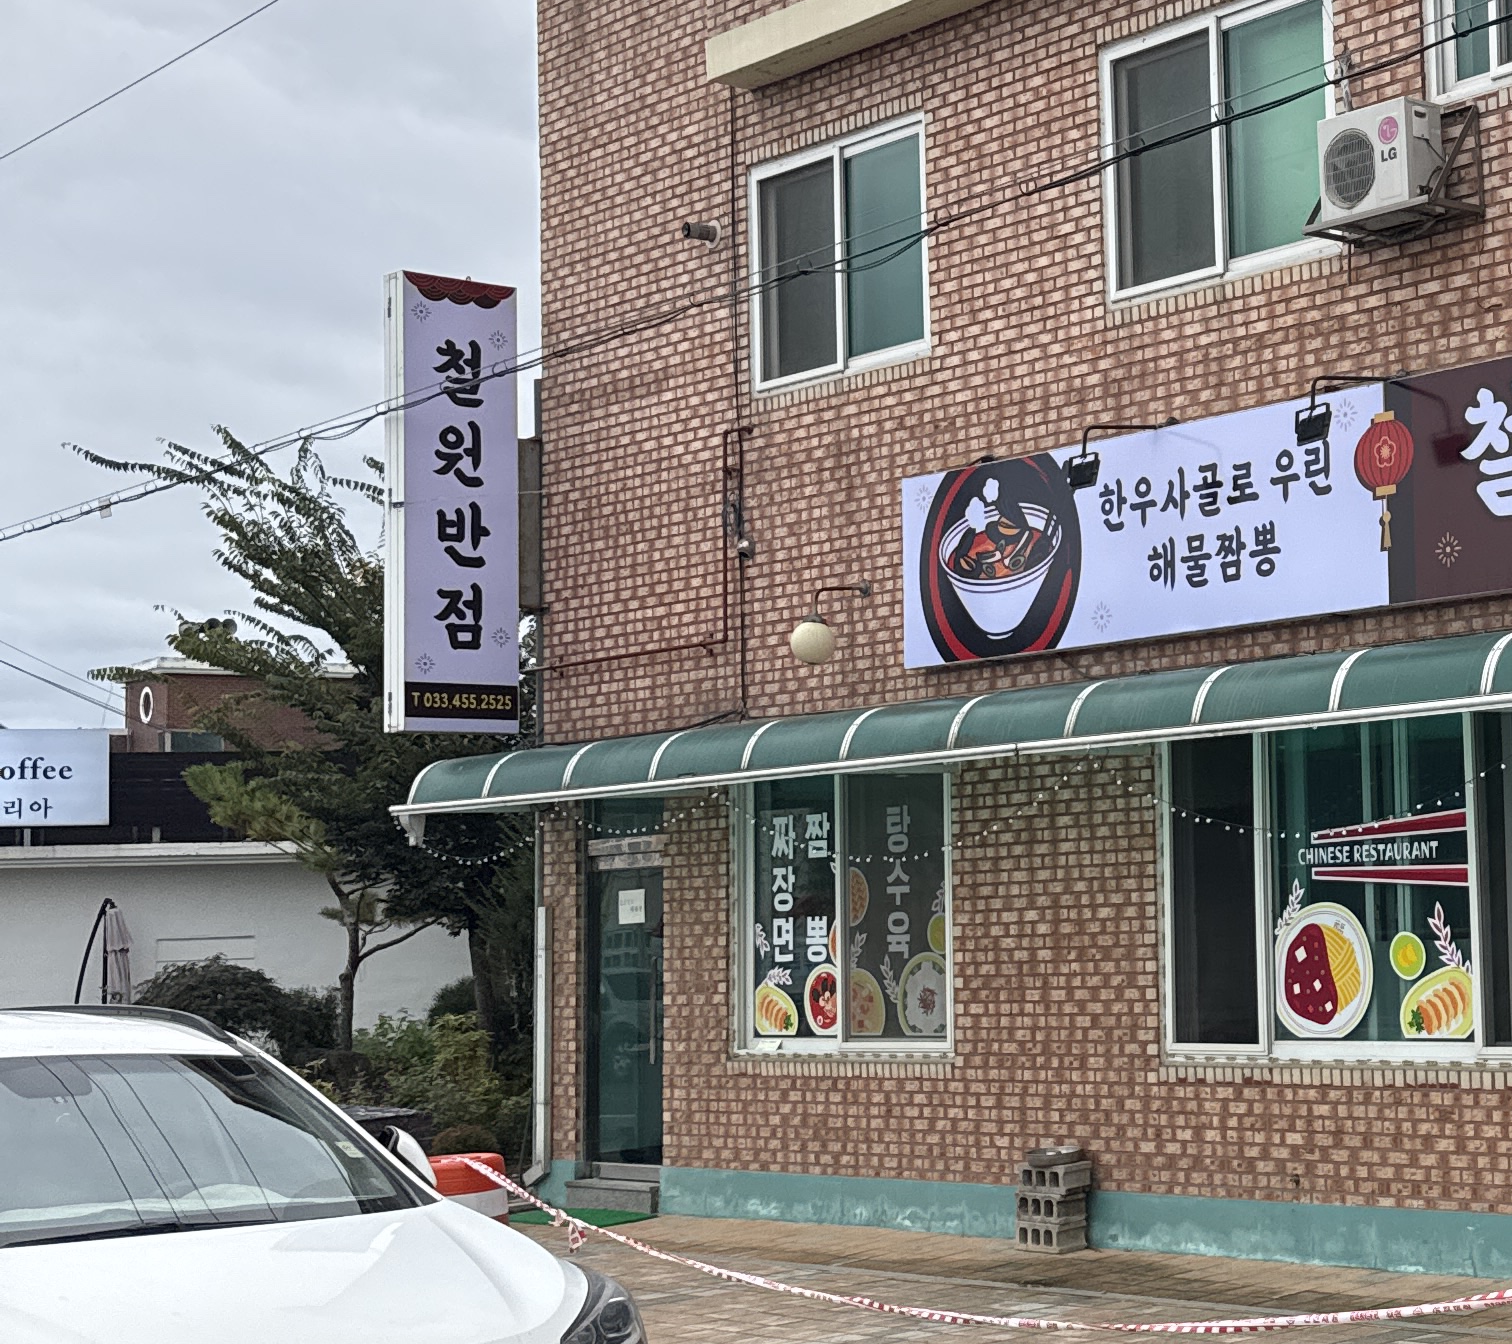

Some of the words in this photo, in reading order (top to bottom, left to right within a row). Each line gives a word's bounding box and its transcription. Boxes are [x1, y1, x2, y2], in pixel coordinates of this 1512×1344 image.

[1380, 146, 1398, 163] LG
[432, 338, 491, 650] 철원반점
[1099, 461, 1260, 532] 한우사골로
[1269, 439, 1333, 504] 우린
[1147, 519, 1282, 592] 해물짬뽕
[411, 691, 421, 708] T
[423, 692, 513, 711] 033.455.2525
[771, 814, 796, 963] 짜장면
[886, 804, 912, 959] 탕수육
[1298, 845, 1351, 865] CHINESE
[1353, 841, 1439, 862] RESTAURANT
